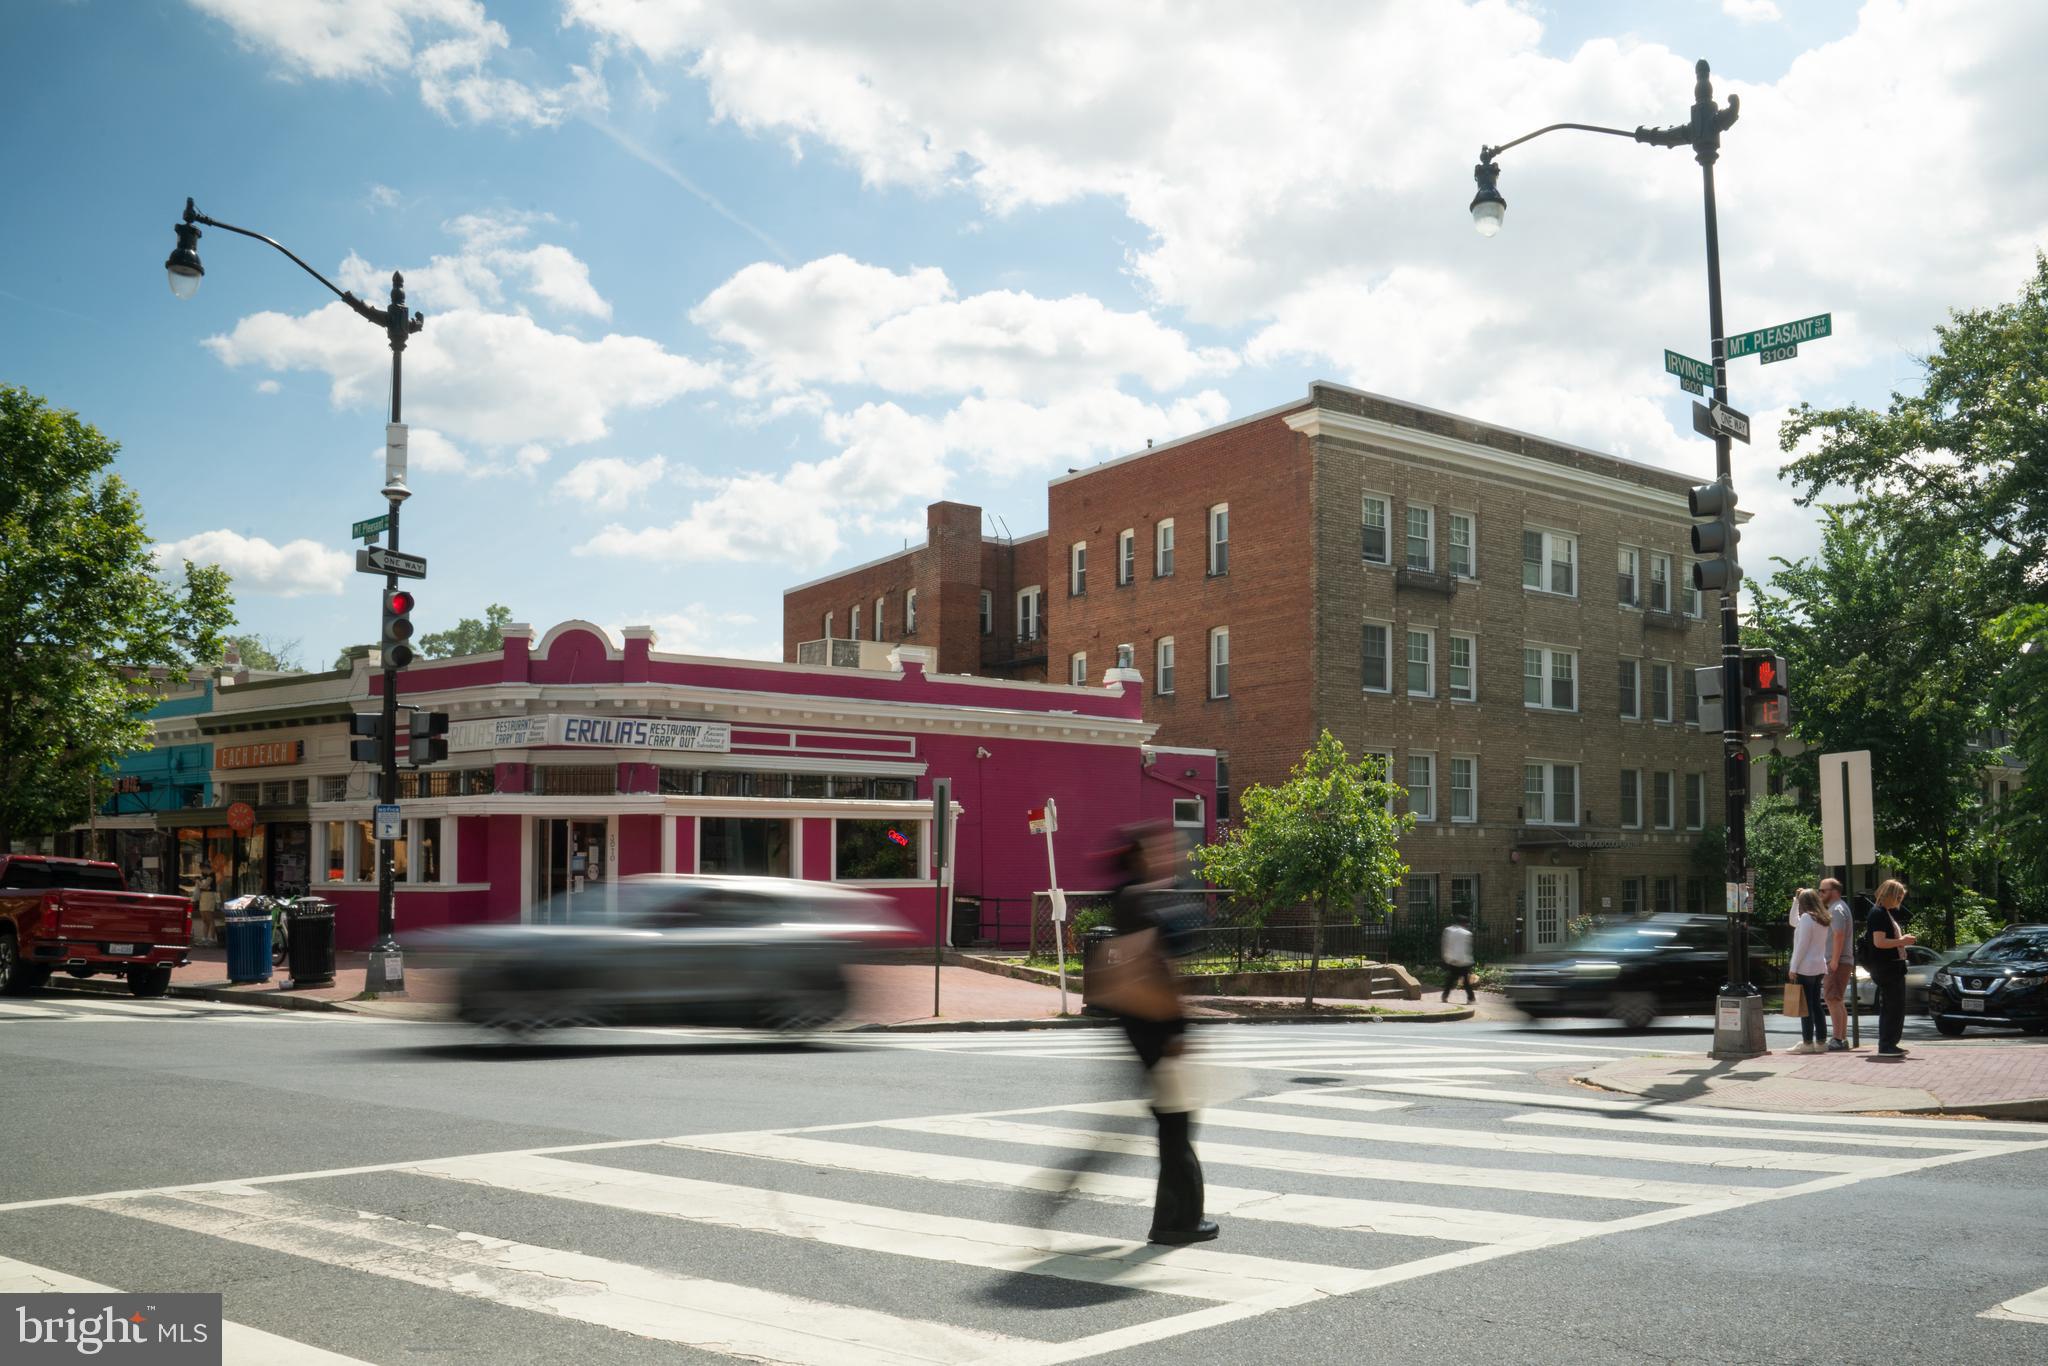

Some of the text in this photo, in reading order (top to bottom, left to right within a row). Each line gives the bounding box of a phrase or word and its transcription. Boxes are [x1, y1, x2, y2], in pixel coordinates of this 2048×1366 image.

[1730, 317, 1827, 355] MT. PLEASANT ST
[1815, 325, 1827, 335] NW
[1762, 345, 1796, 363] 3100
[1667, 353, 1704, 381] IRVING
[1682, 378, 1703, 395] 1600
[1721, 411, 1746, 434] ONE WAY
[384, 556, 423, 571] ONE WAY
[496, 719, 532, 732] RESTAURANT
[565, 718, 648, 745] ERCILIA'S
[650, 723, 702, 737] RESTAURANT
[495, 731, 527, 745] CARRY OUT
[648, 735, 676, 747] CARRY
[679, 736, 696, 749] OUT
[222, 743, 288, 767] EACH PEACH
